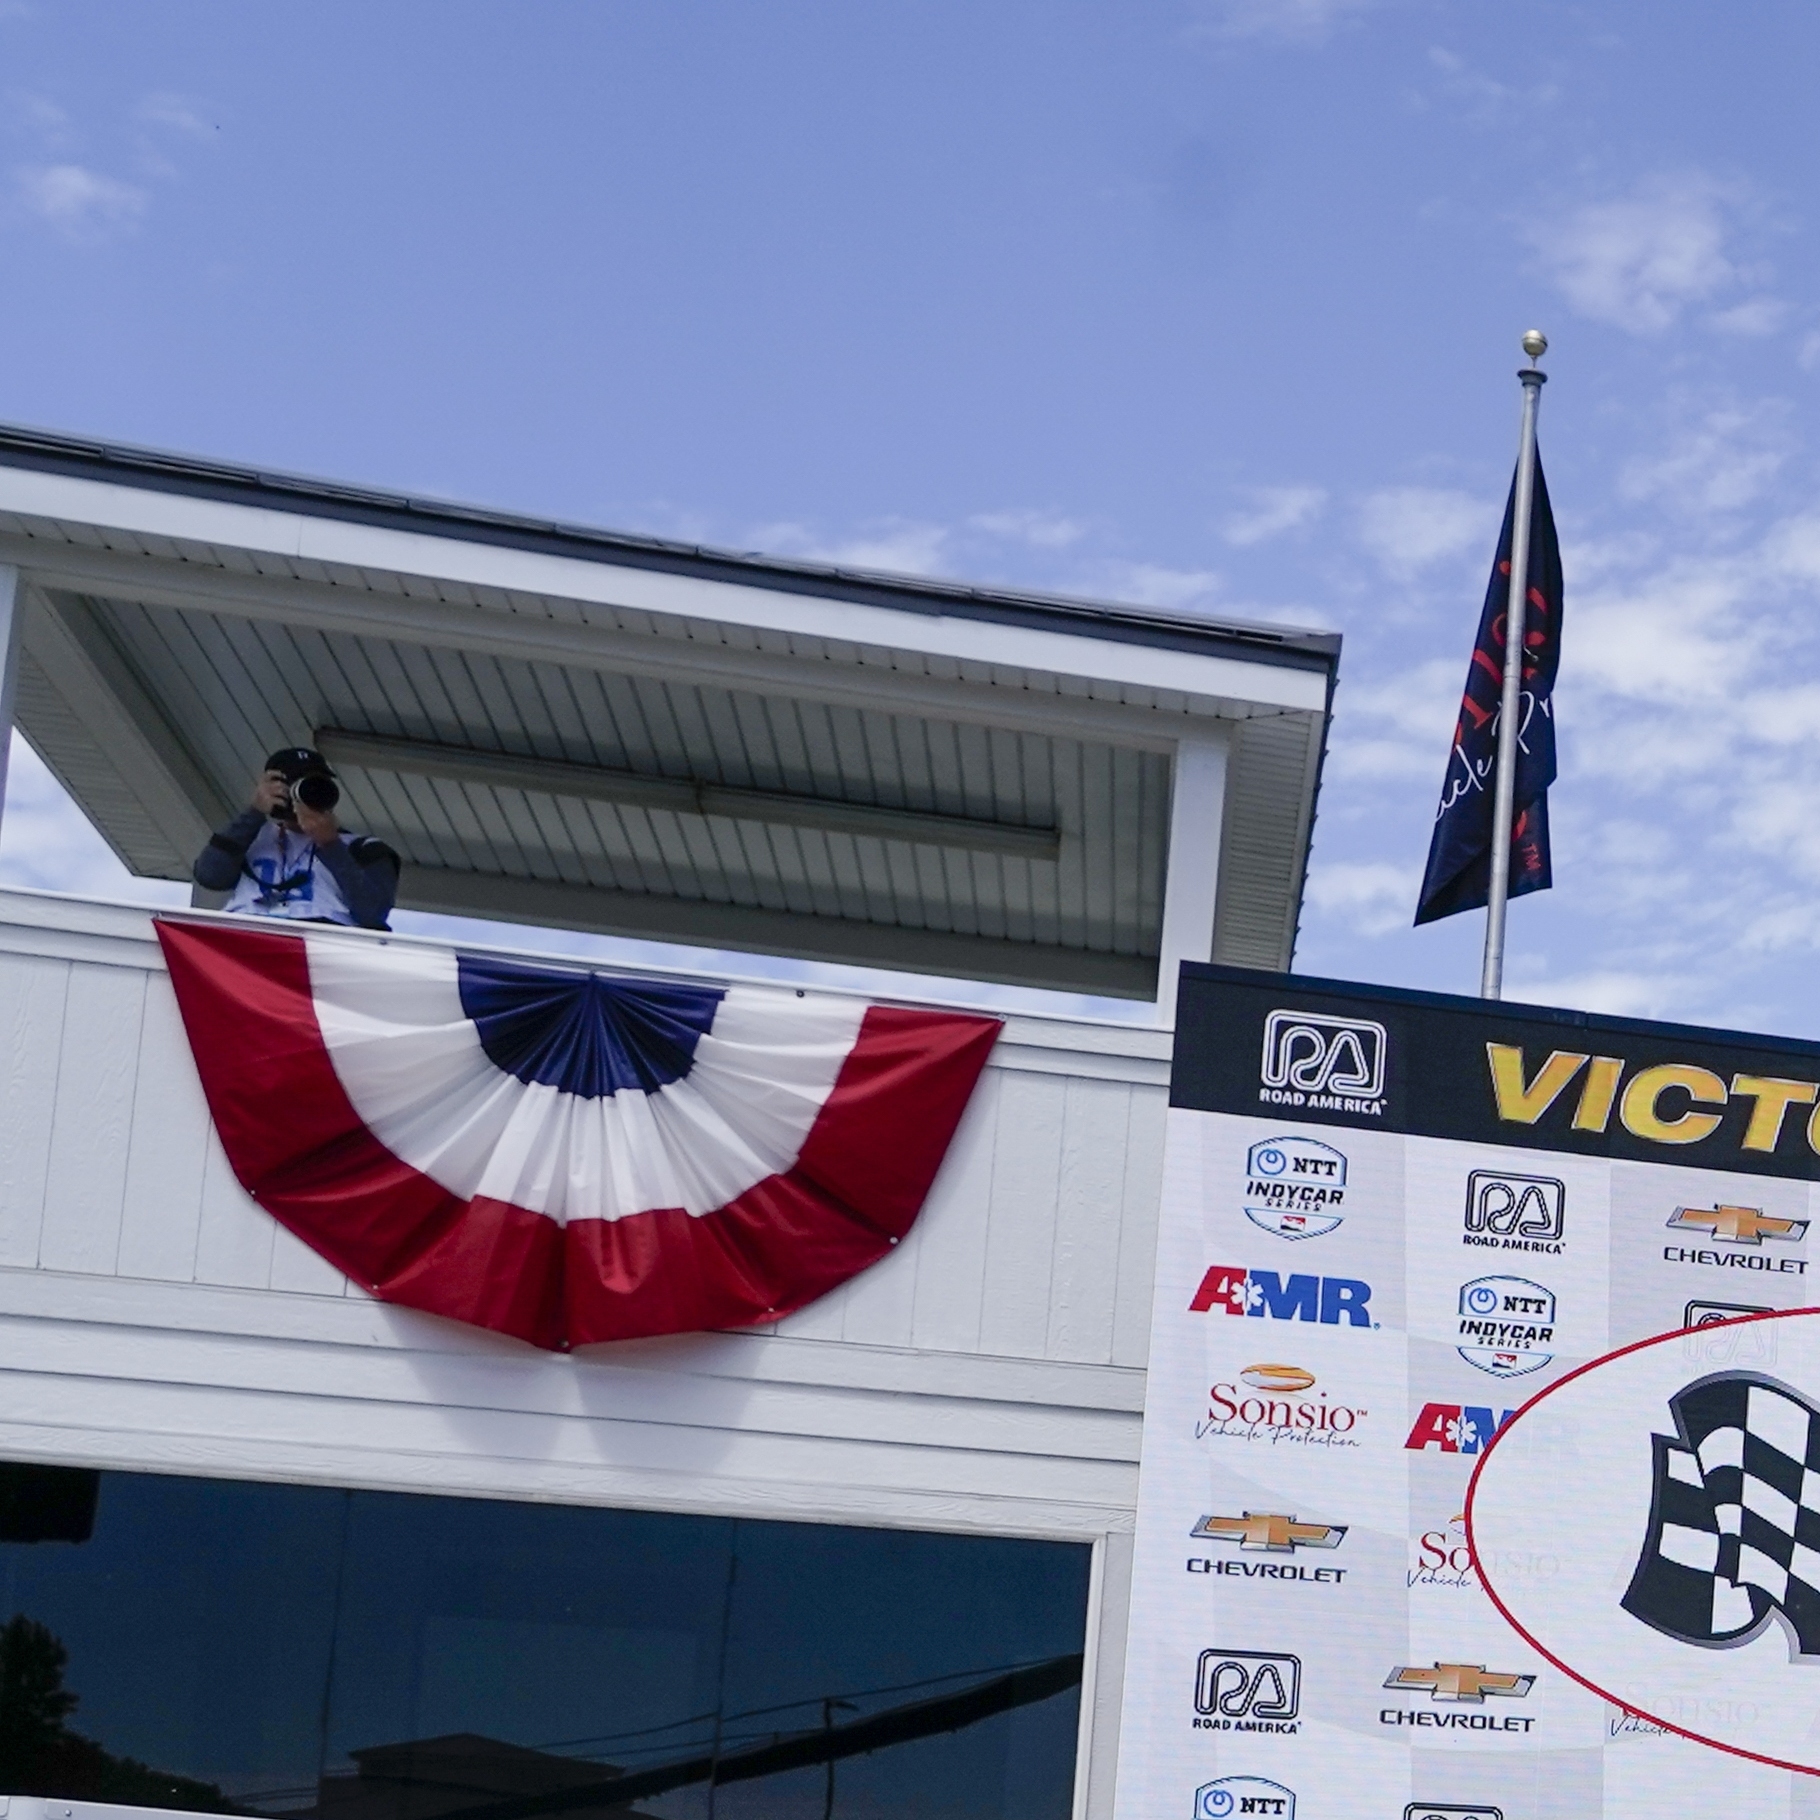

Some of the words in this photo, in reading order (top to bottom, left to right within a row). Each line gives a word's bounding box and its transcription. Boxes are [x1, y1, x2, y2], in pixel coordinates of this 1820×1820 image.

[1260, 1088, 1305, 1105] ROAD
[1308, 1095, 1381, 1115] AMERICA
[1293, 1157, 1337, 1176] NTT
[1247, 1181, 1346, 1205] INDYCAR
[1463, 1235, 1499, 1247] ROAD
[1502, 1239, 1561, 1254] AMERICA
[1664, 1247, 1808, 1274] CHEVROLET
[1188, 1266, 1371, 1328] AMR
[1504, 1296, 1546, 1314] NTT
[1460, 1320, 1555, 1342] INDYCAR
[1208, 1383, 1354, 1431] Sonsio
[1187, 1559, 1346, 1583] CHEVROLET
[1193, 1718, 1231, 1730] ROAD
[1235, 1721, 1296, 1734] AMERICA
[1380, 1710, 1535, 1732] CHEVROLET
[1240, 1797, 1285, 1814] NTT
